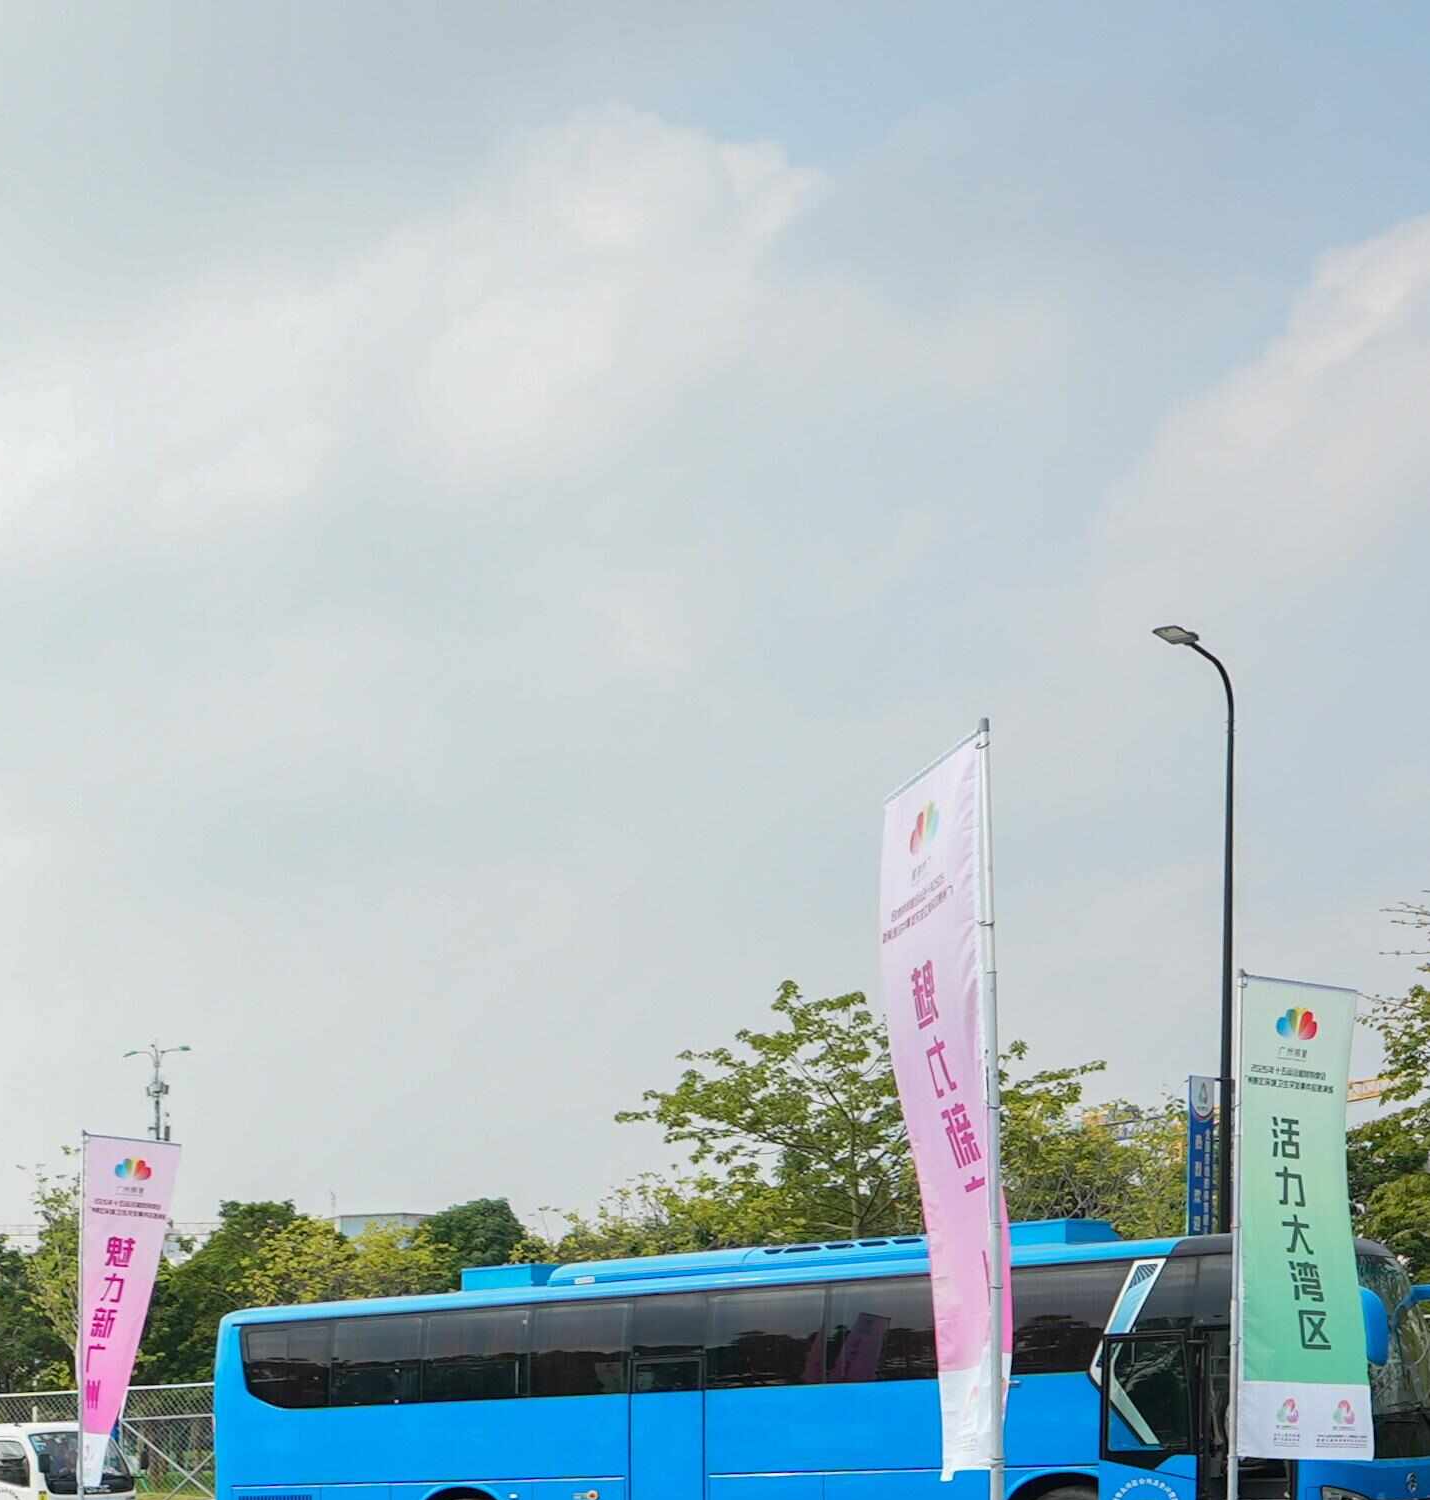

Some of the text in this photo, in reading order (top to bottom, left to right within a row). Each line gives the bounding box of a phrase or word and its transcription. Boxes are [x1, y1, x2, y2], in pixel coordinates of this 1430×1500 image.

[85, 1235, 136, 1410] 魅力新广州
[1271, 1116, 1332, 1351] 活力大湾区
